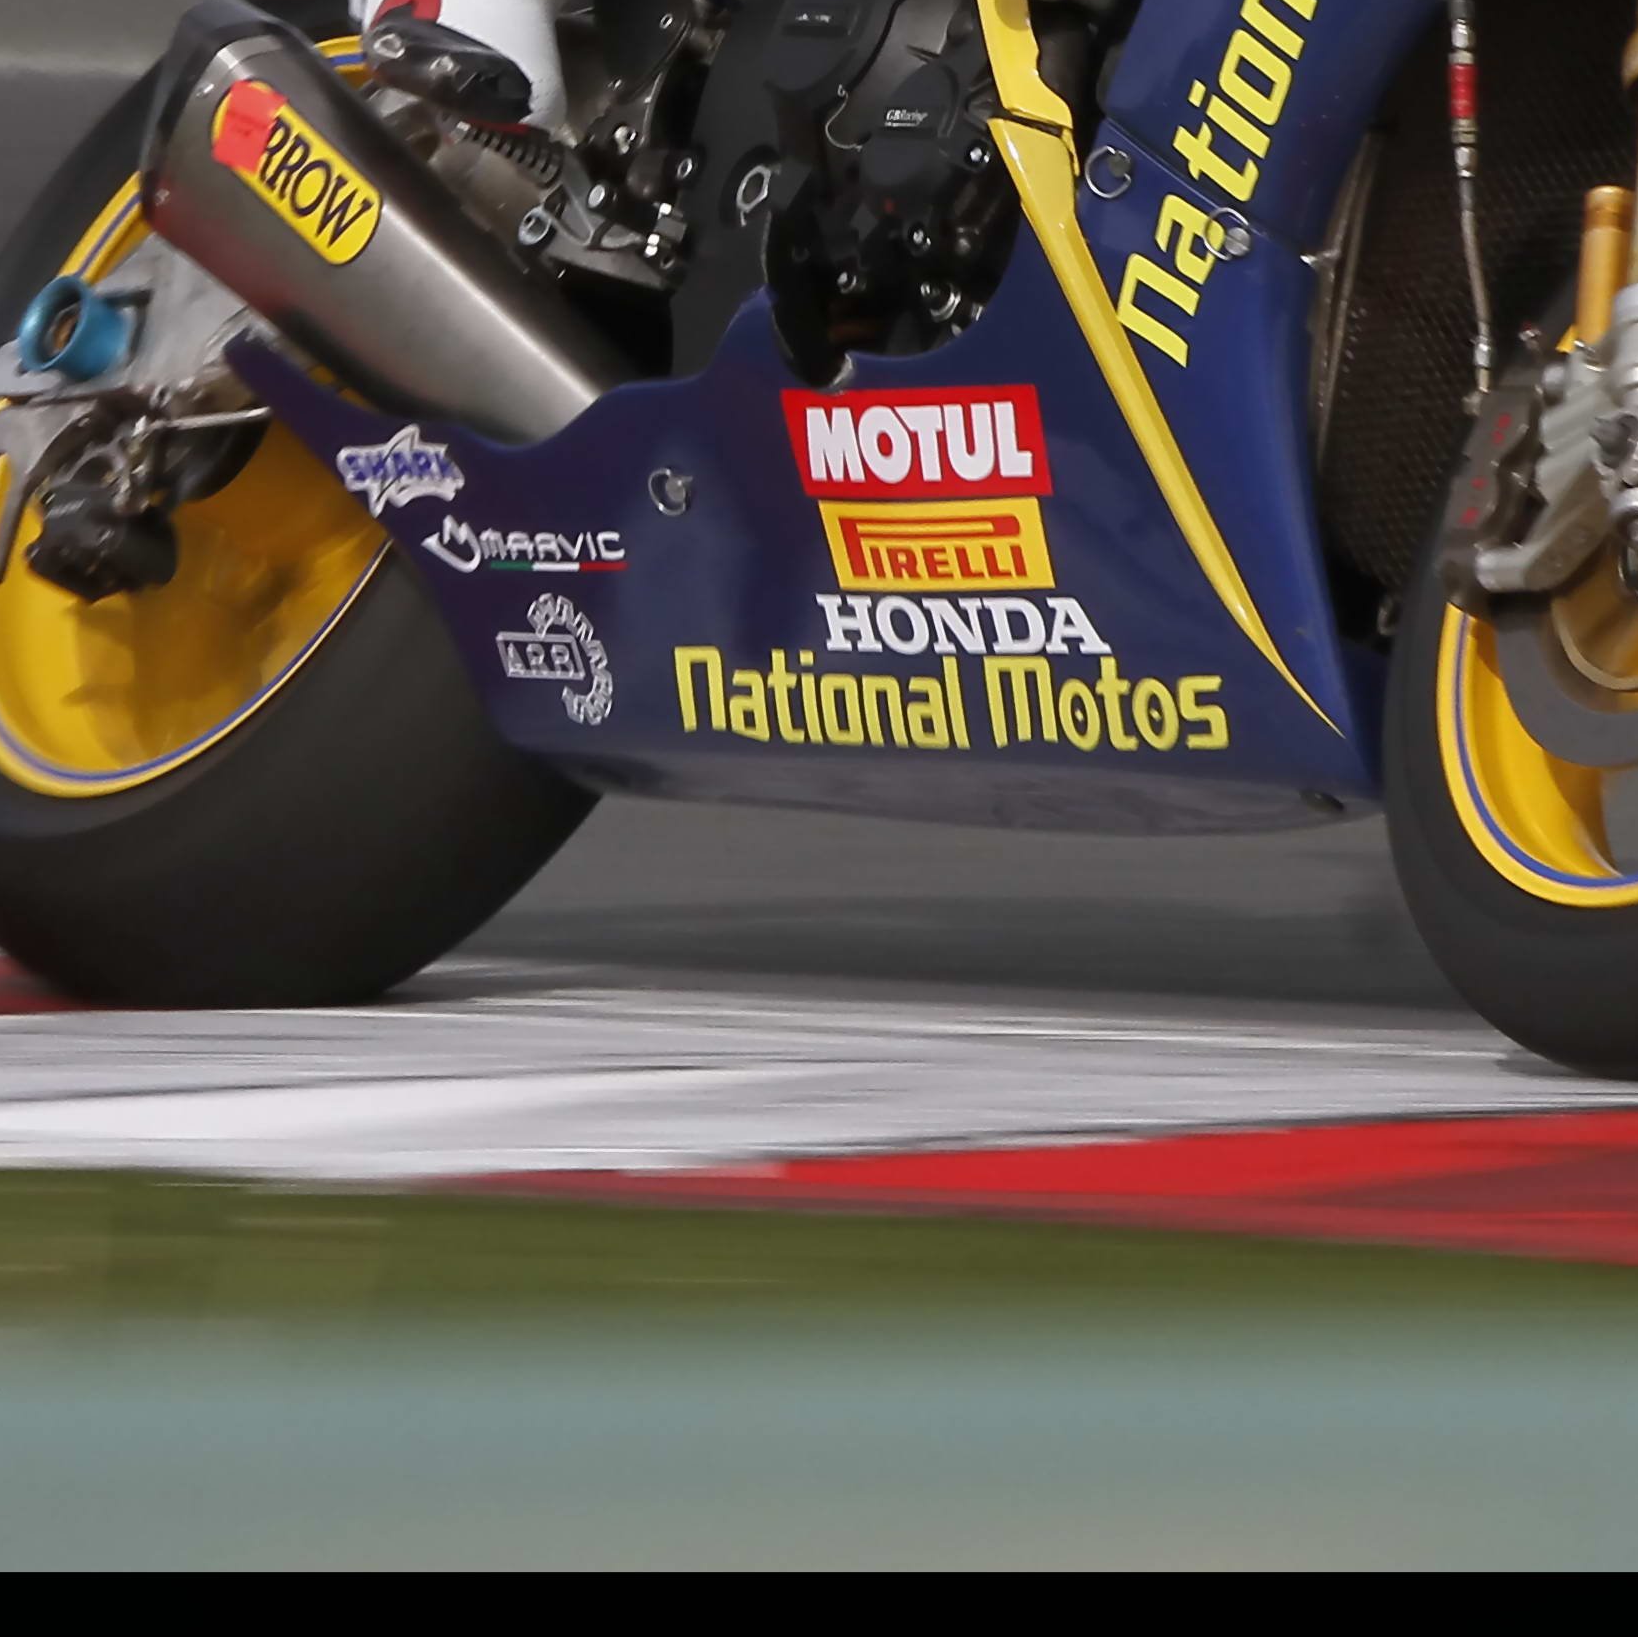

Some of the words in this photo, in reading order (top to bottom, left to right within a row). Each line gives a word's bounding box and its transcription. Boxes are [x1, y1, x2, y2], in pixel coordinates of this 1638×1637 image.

[259, 114, 375, 250] RROW
[805, 401, 1033, 484] MOTUL
[838, 513, 1028, 583] PIRELLI
[815, 593, 1110, 657] HONDA
